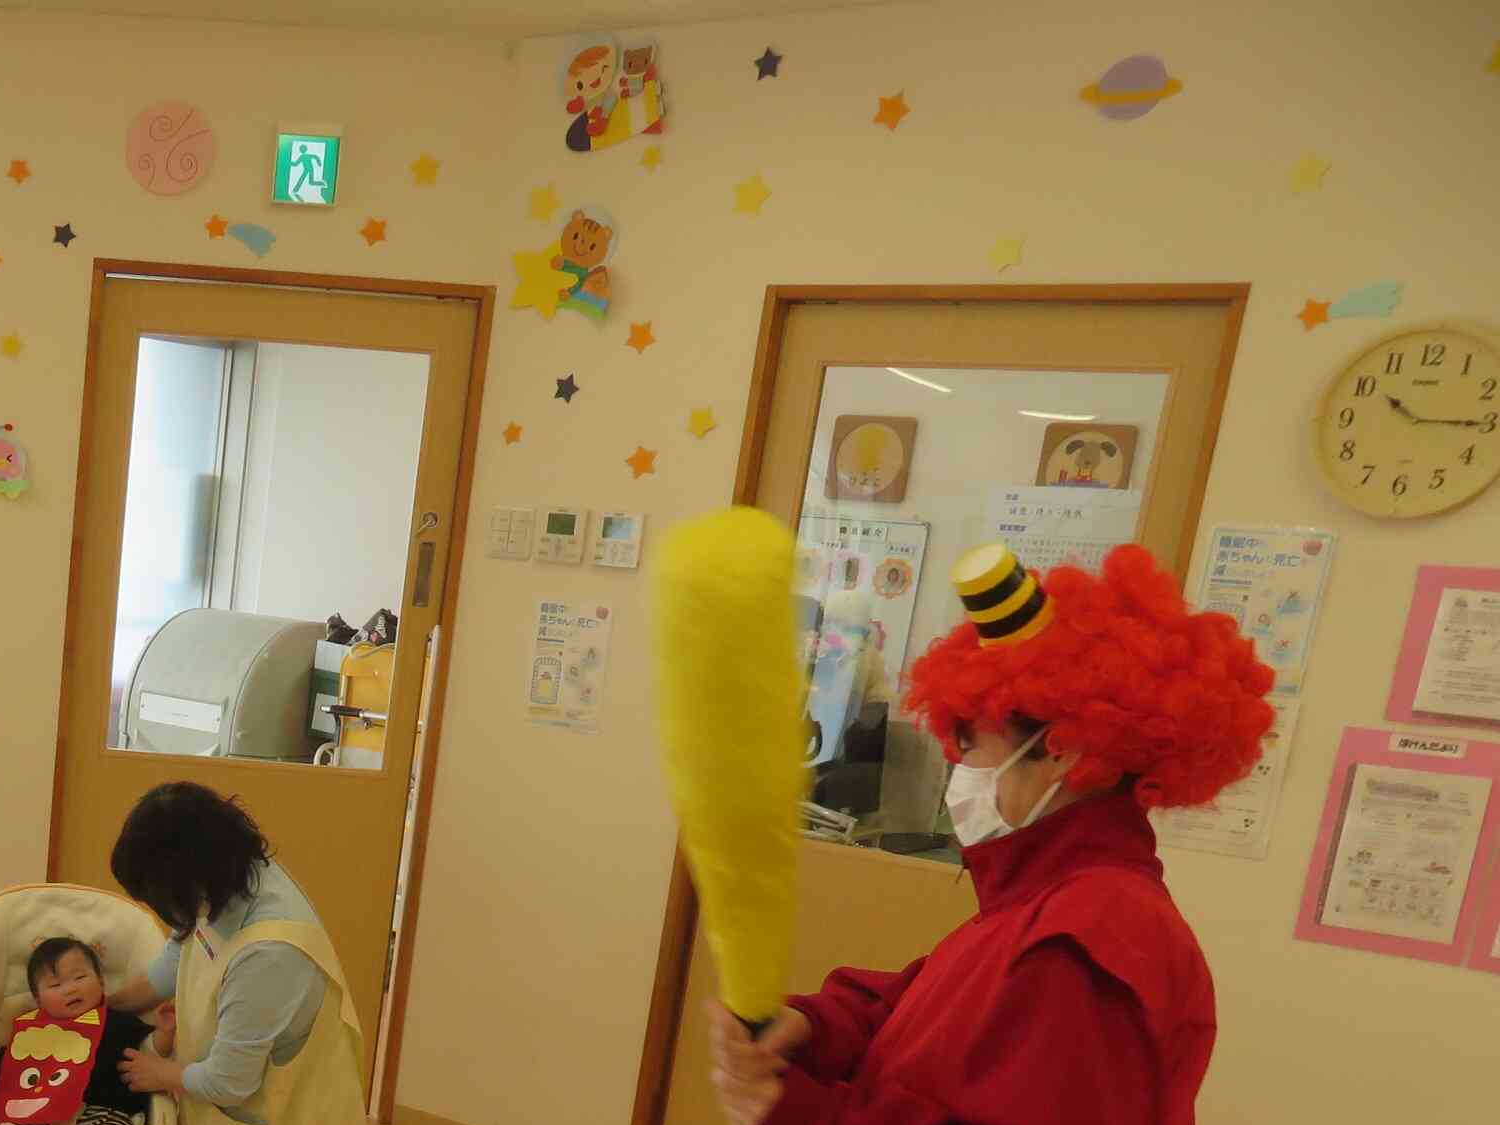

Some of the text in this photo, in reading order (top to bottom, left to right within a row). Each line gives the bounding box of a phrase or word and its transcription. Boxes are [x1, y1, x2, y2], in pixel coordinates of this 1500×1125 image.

[1384, 352, 1404, 375] 11
[1420, 343, 1446, 367] 12
[1460, 353, 1473, 376] 1
[1354, 375, 1376, 397] 10
[1479, 378, 1497, 400] 2
[1338, 407, 1355, 430] 9
[1479, 412, 1498, 434] 3
[1339, 440, 1356, 461] 8
[1459, 444, 1475, 465] 4
[1361, 465, 1376, 485] 7
[1392, 474, 1408, 496] 6
[1429, 468, 1447, 490] 5
